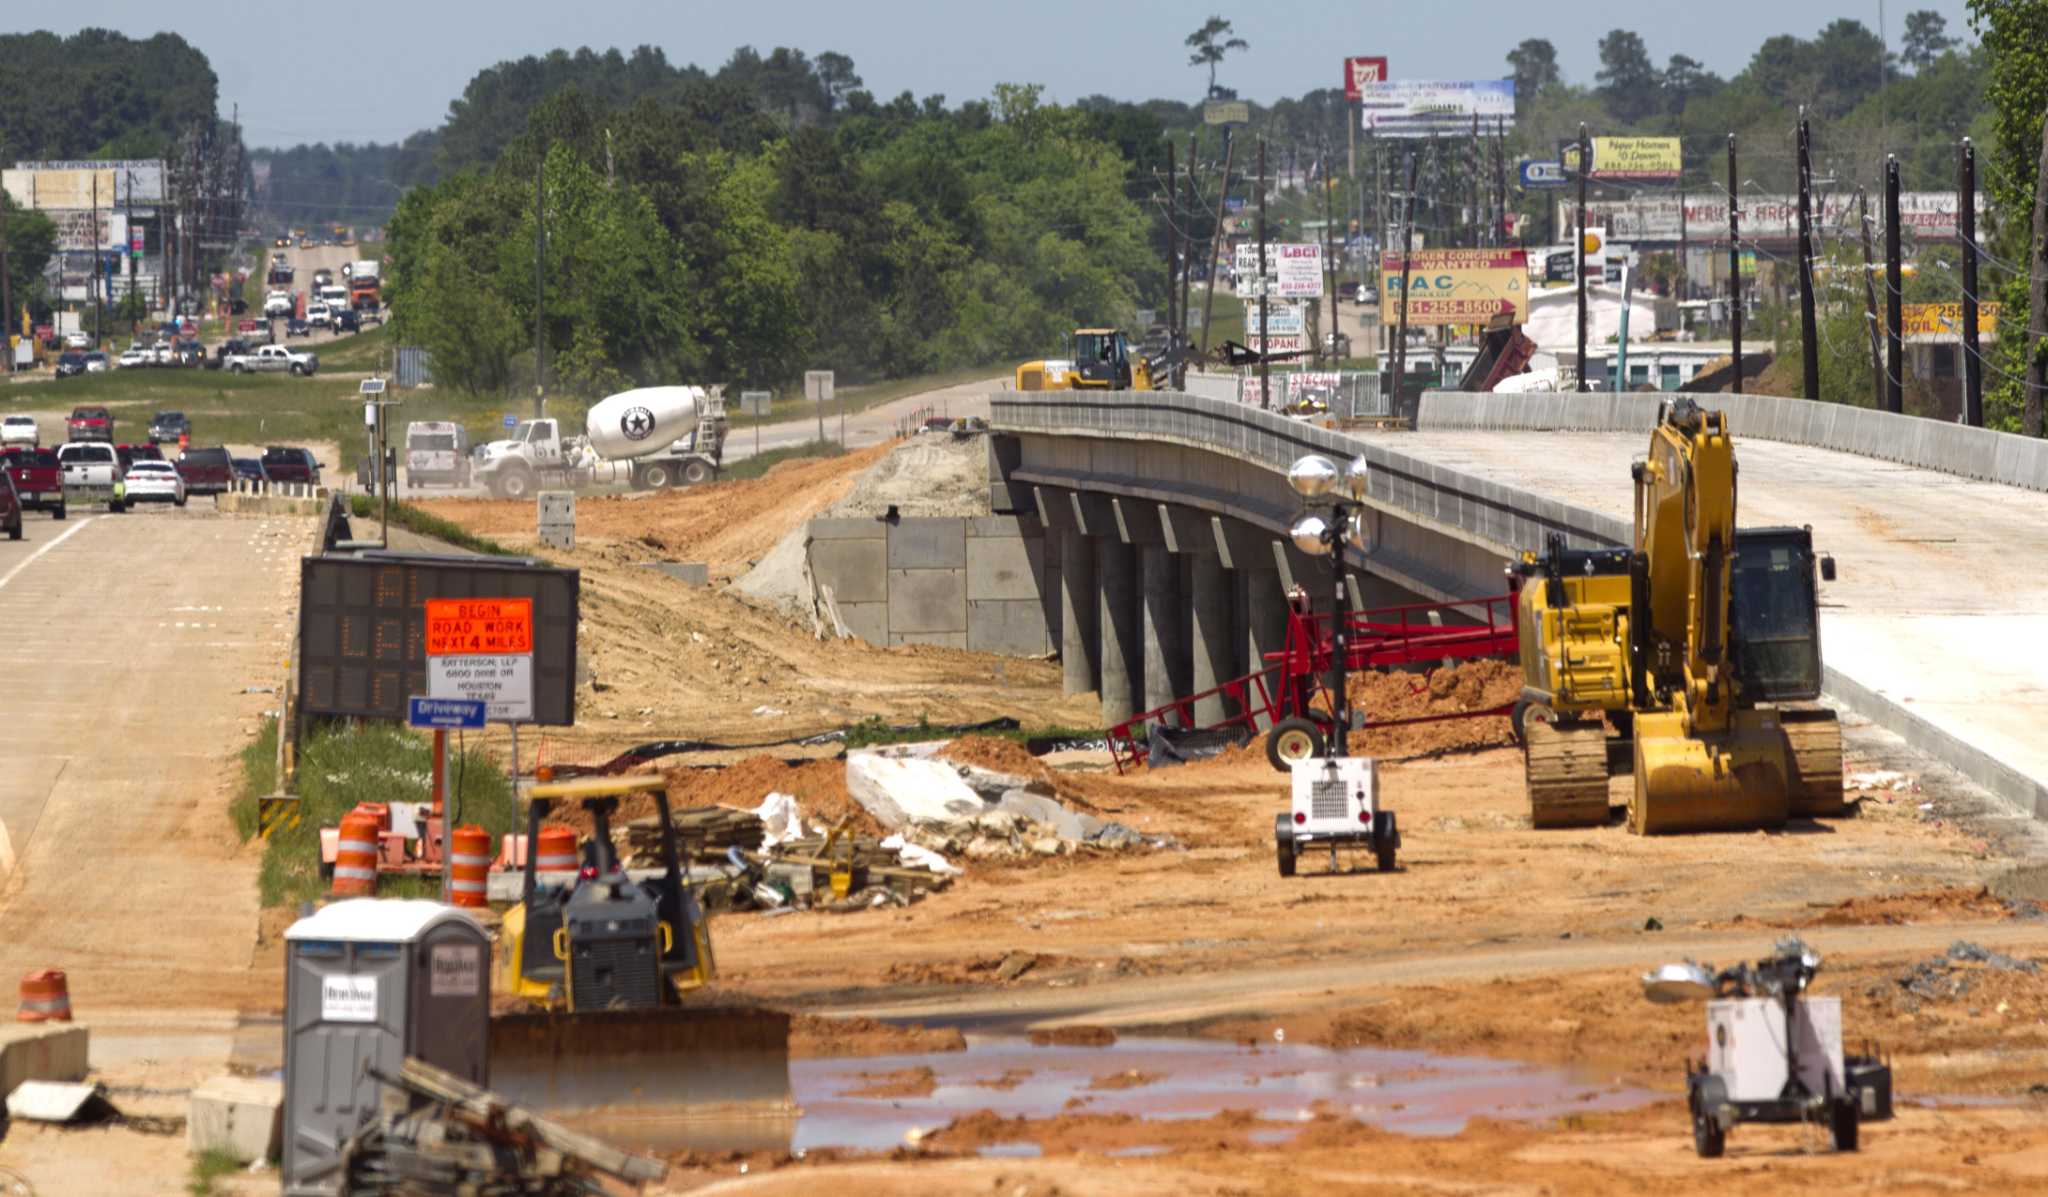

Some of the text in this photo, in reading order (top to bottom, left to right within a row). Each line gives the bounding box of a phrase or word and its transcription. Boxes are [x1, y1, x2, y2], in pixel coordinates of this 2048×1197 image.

[1449, 249, 1512, 261] CONCRETE
[1421, 260, 1491, 270] WANTED
[1399, 301, 1502, 314] 81-255-8500
[1253, 337, 1300, 349] POPANE
[458, 604, 500, 619] BEGIN
[433, 621, 524, 634] ROAD WORK
[432, 635, 526, 649] NEXT 4 MILES
[457, 681, 502, 691] HOUSTON
[418, 701, 478, 719] Driveway
